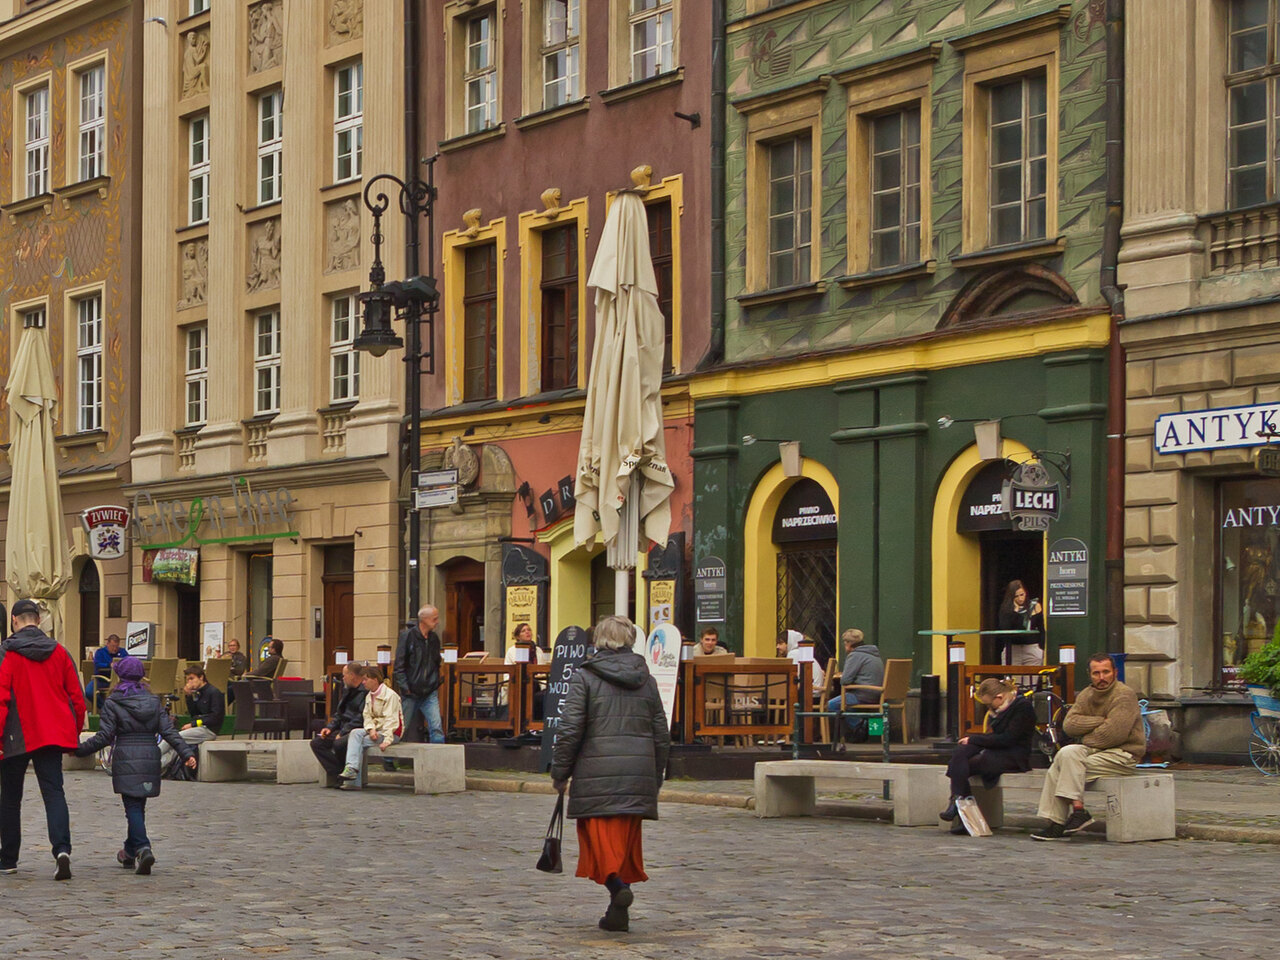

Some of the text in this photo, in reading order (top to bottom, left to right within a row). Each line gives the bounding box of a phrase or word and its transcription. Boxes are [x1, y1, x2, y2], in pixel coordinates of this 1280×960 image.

[133, 476, 296, 537] Green line
[1015, 491, 1054, 509] LECH
[1023, 516, 1049, 528] PILS
[1049, 550, 1086, 562] ANTYKI
[696, 566, 725, 578] ANTYKI
[555, 644, 586, 658] PIWO
[549, 682, 570, 695] WOD
[735, 695, 760, 708] PILS
